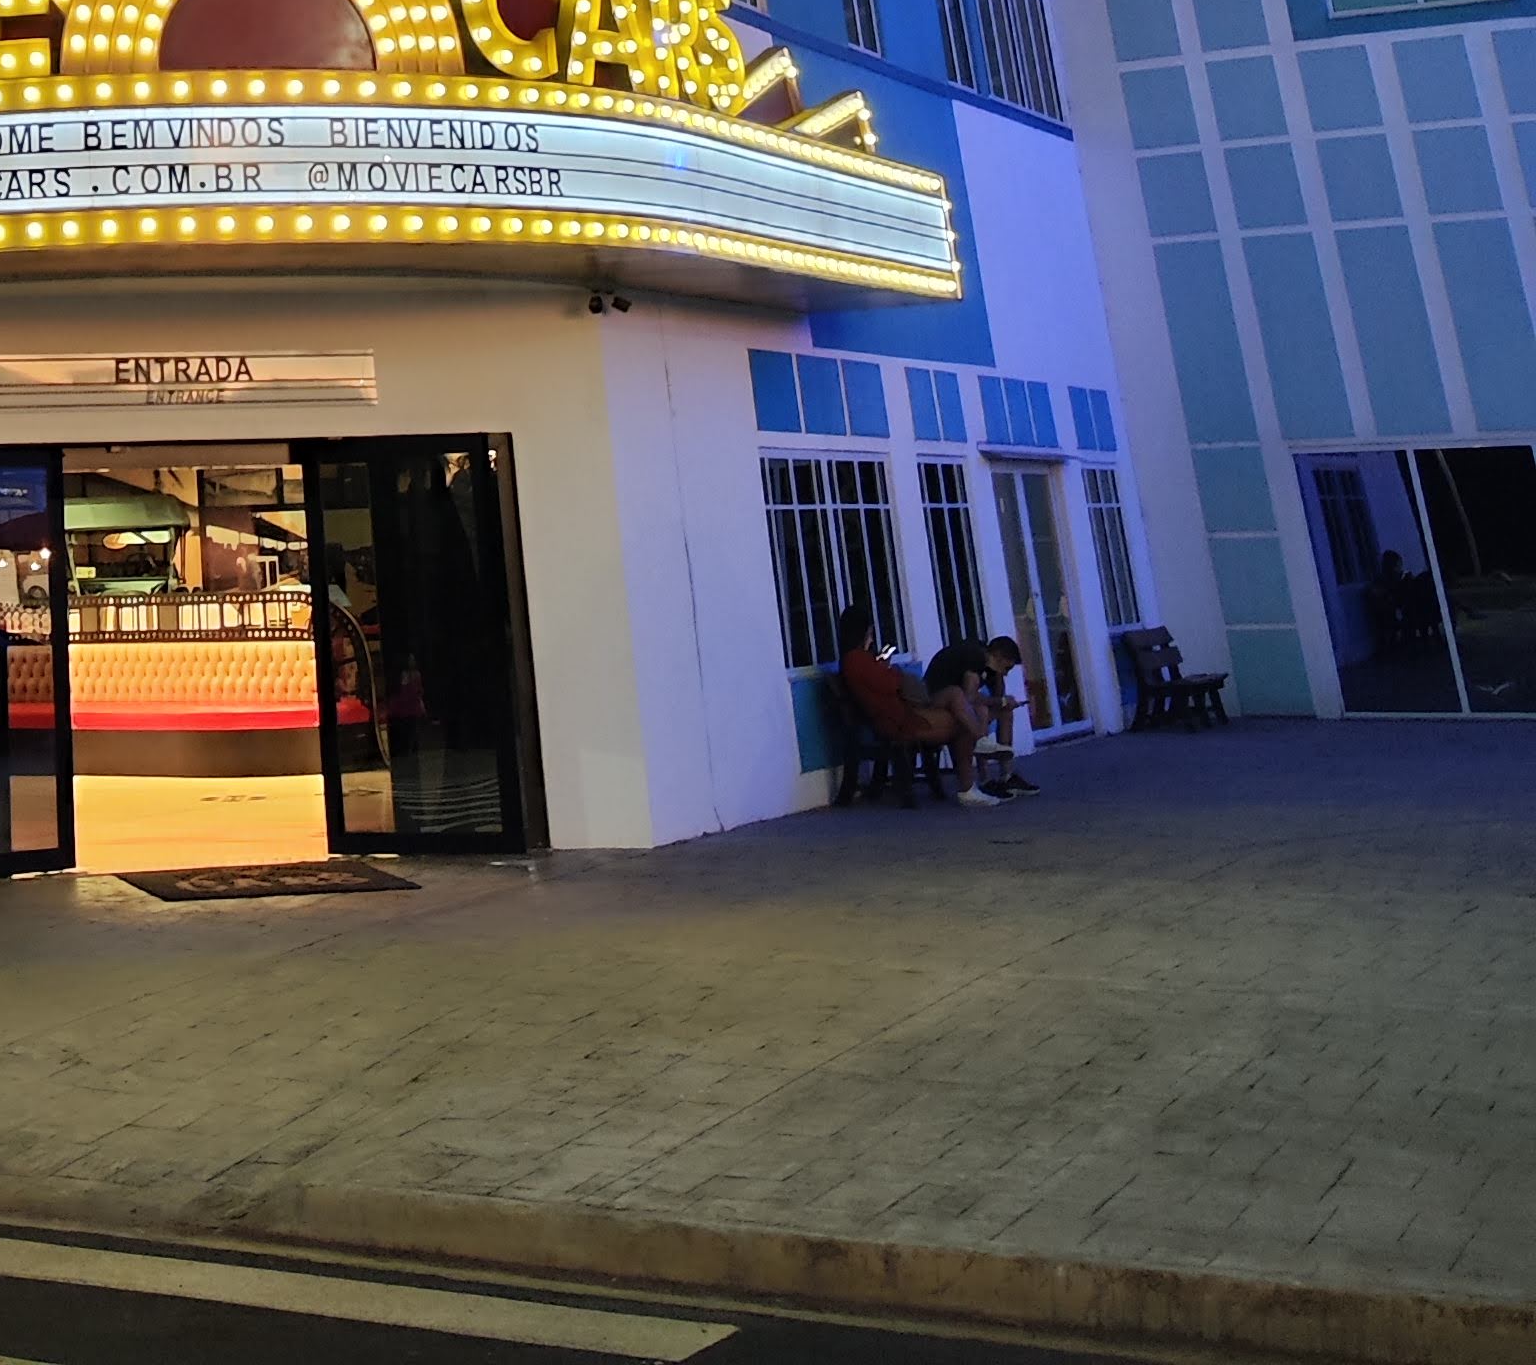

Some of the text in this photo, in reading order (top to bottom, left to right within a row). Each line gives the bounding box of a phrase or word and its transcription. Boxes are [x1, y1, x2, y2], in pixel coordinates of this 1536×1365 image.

[330, 118, 540, 153] BIENVENIDOS
[307, 162, 565, 197] @MOVIECARSBR
[114, 356, 254, 384] ENTRADA
